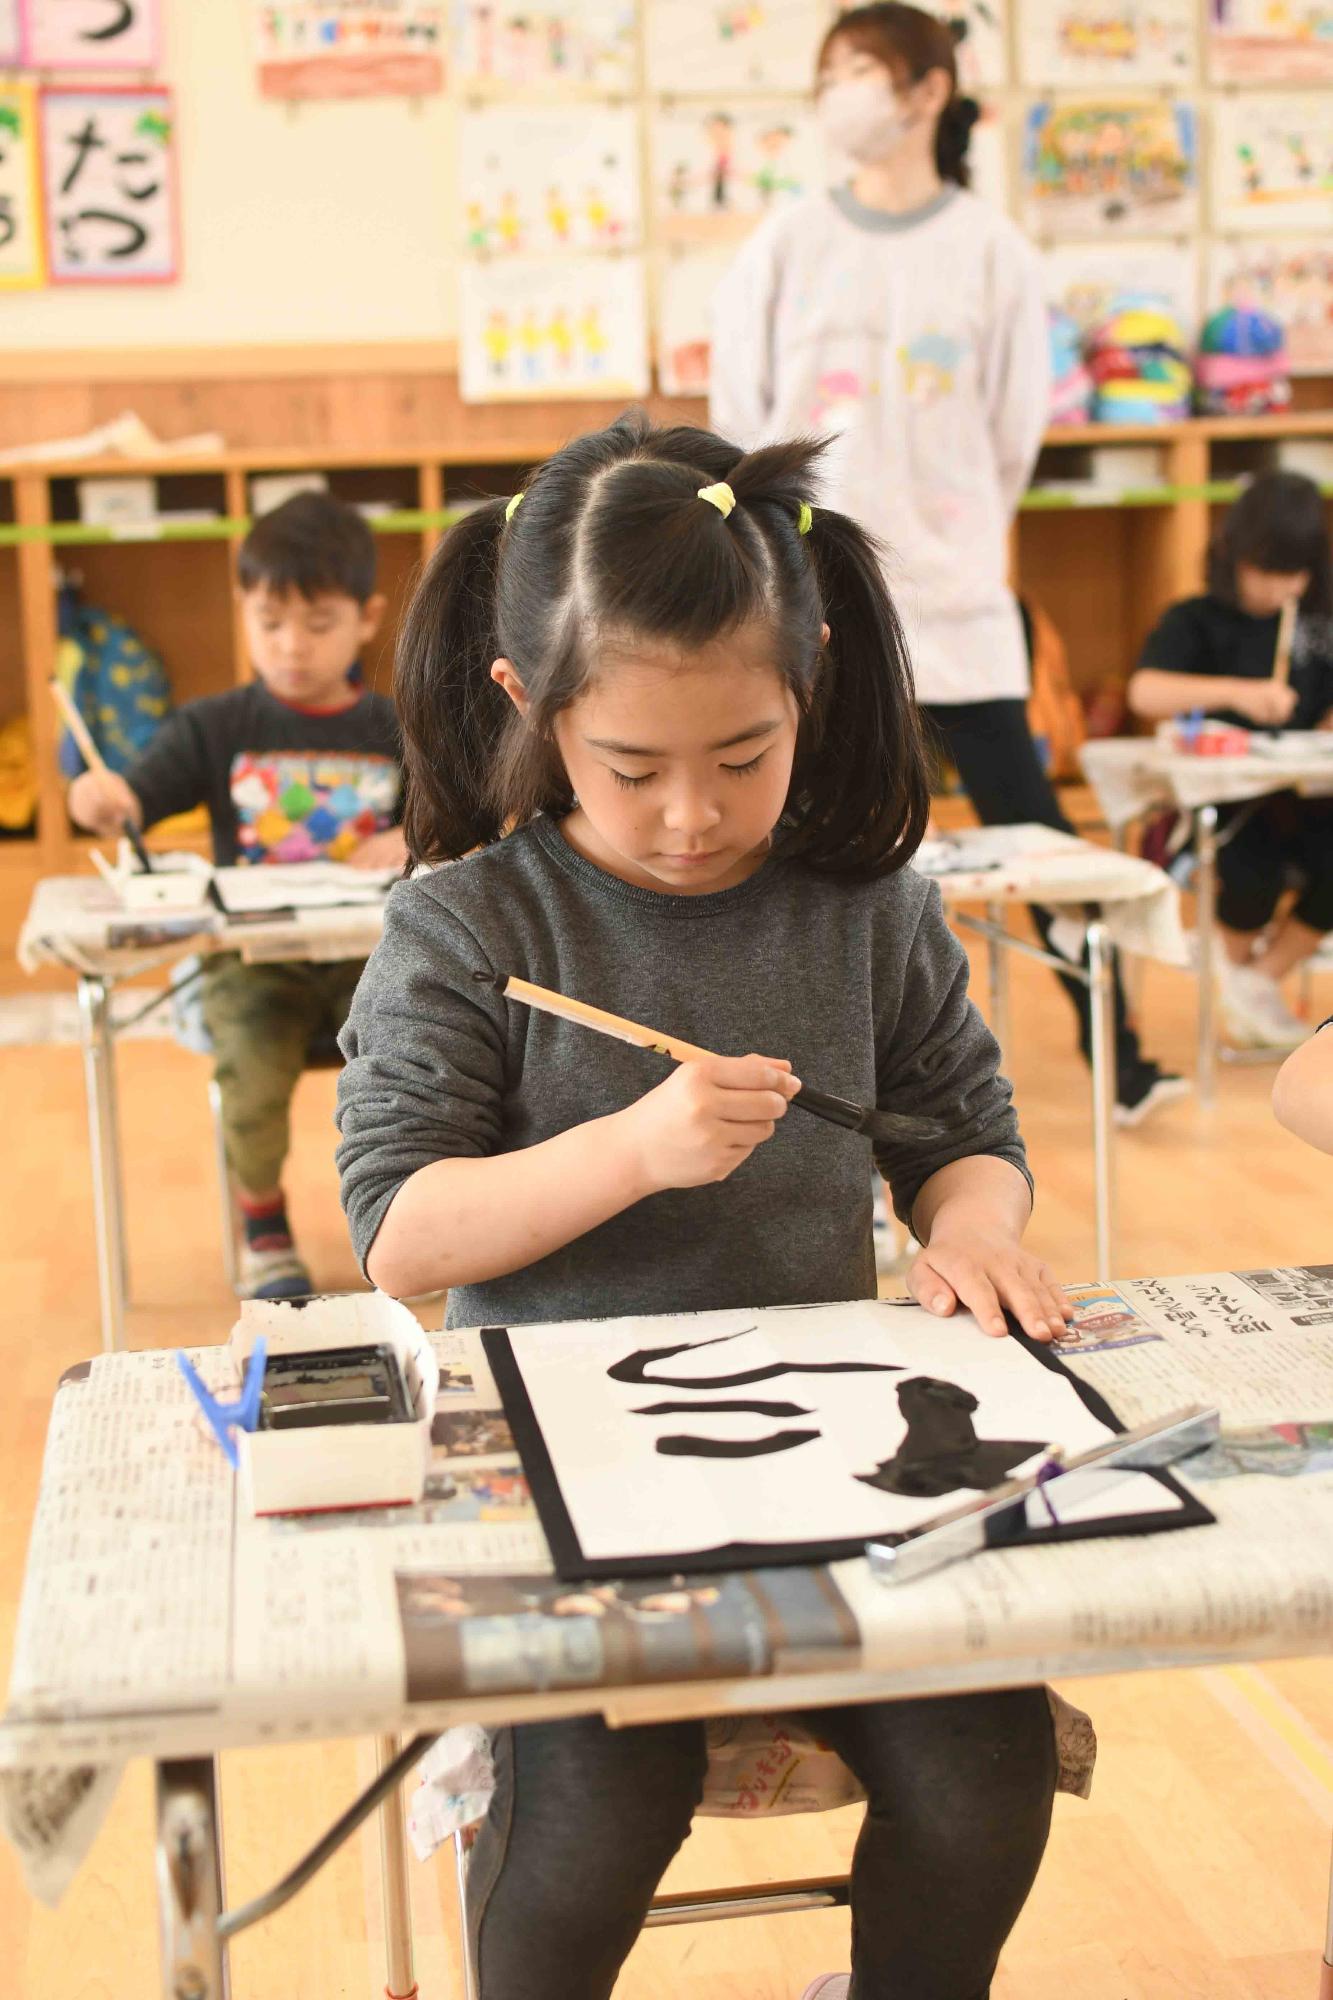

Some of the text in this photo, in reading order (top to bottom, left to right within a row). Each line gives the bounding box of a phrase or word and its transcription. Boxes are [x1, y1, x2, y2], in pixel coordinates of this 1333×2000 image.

[61, 117, 159, 260] たつ
[1130, 1277, 1209, 1338] もう耐えられな
